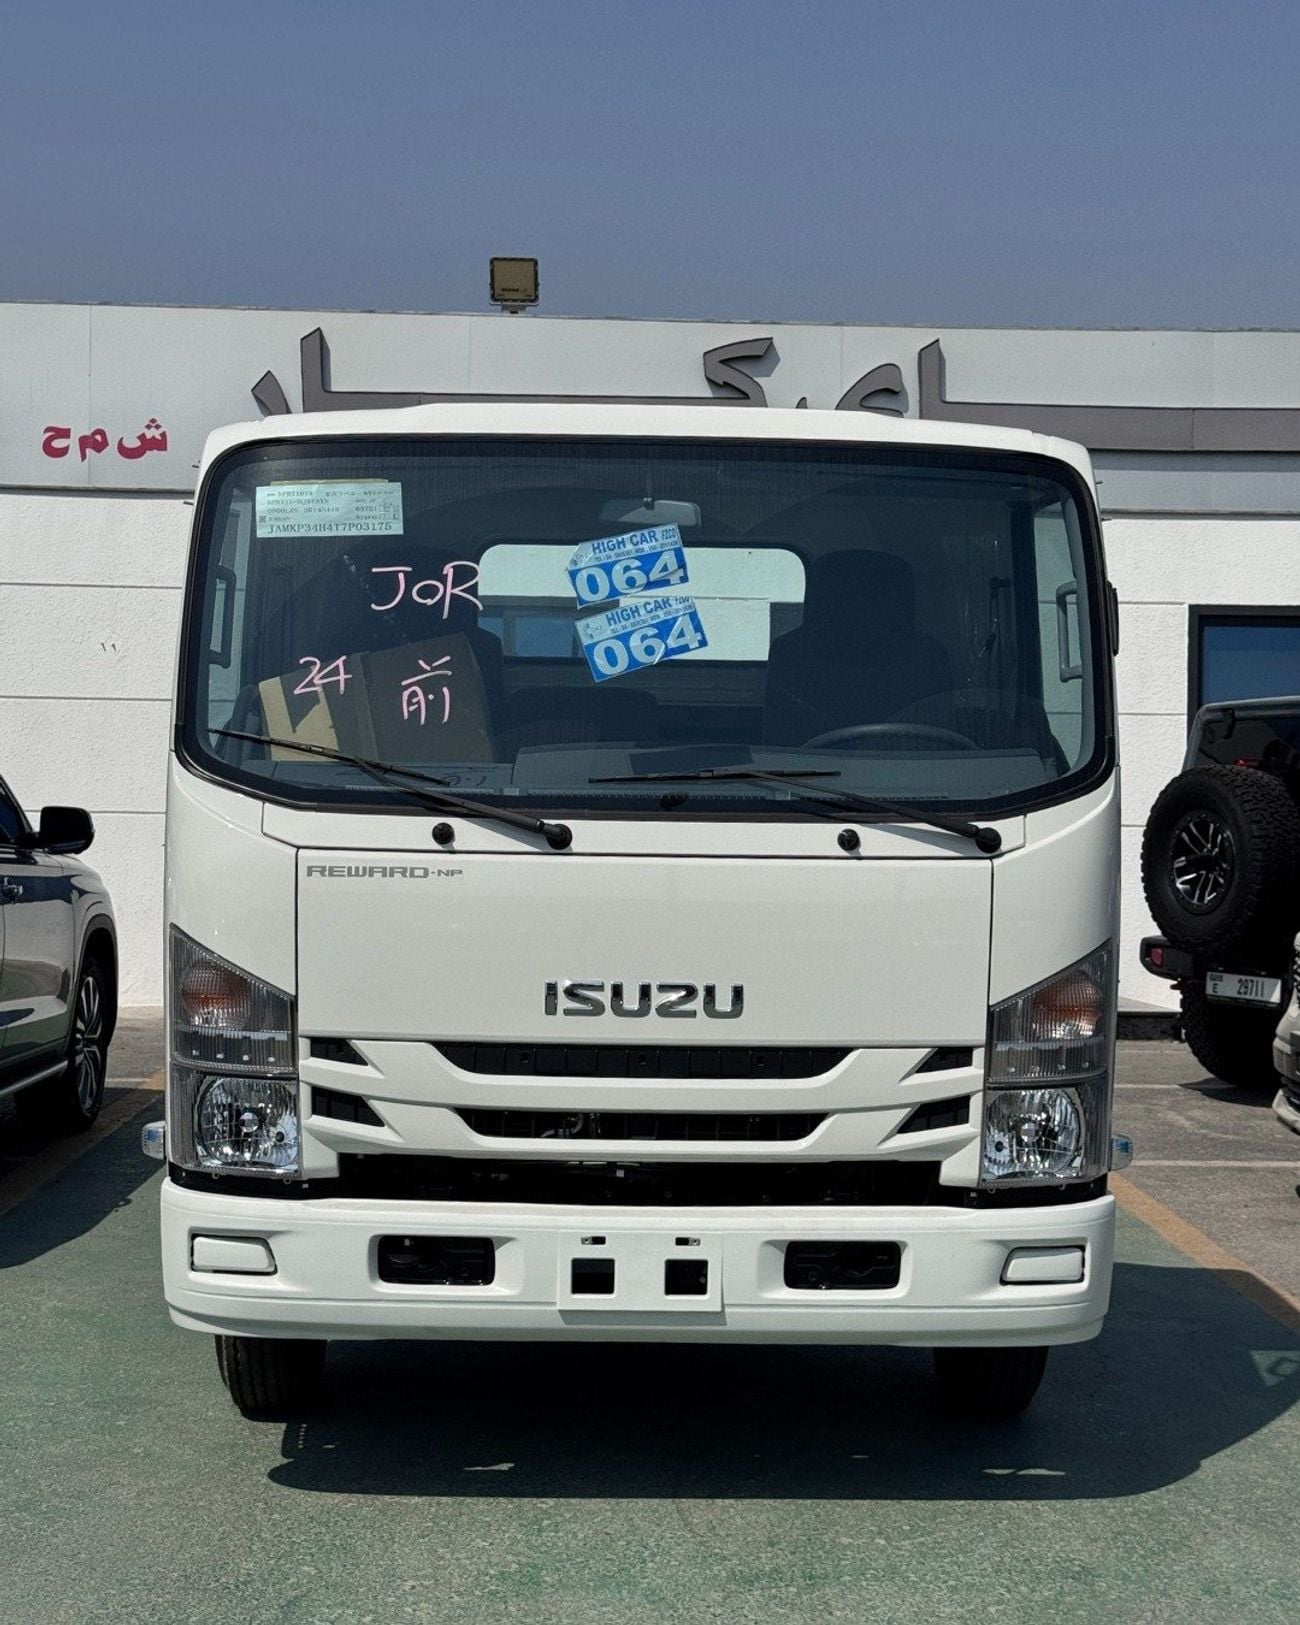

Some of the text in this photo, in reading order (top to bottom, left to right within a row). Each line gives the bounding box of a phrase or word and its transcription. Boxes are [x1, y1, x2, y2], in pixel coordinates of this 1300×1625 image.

[592, 537, 626, 555] HIGH
[629, 530, 659, 547] CAR
[575, 550, 684, 602] 064
[605, 605, 642, 627] HIGH
[643, 597, 673, 615] CAR
[593, 613, 703, 675] 064
[293, 655, 353, 696] 24
[544, 978, 745, 1019] ISUZU
[1237, 977, 1266, 998] 29711
